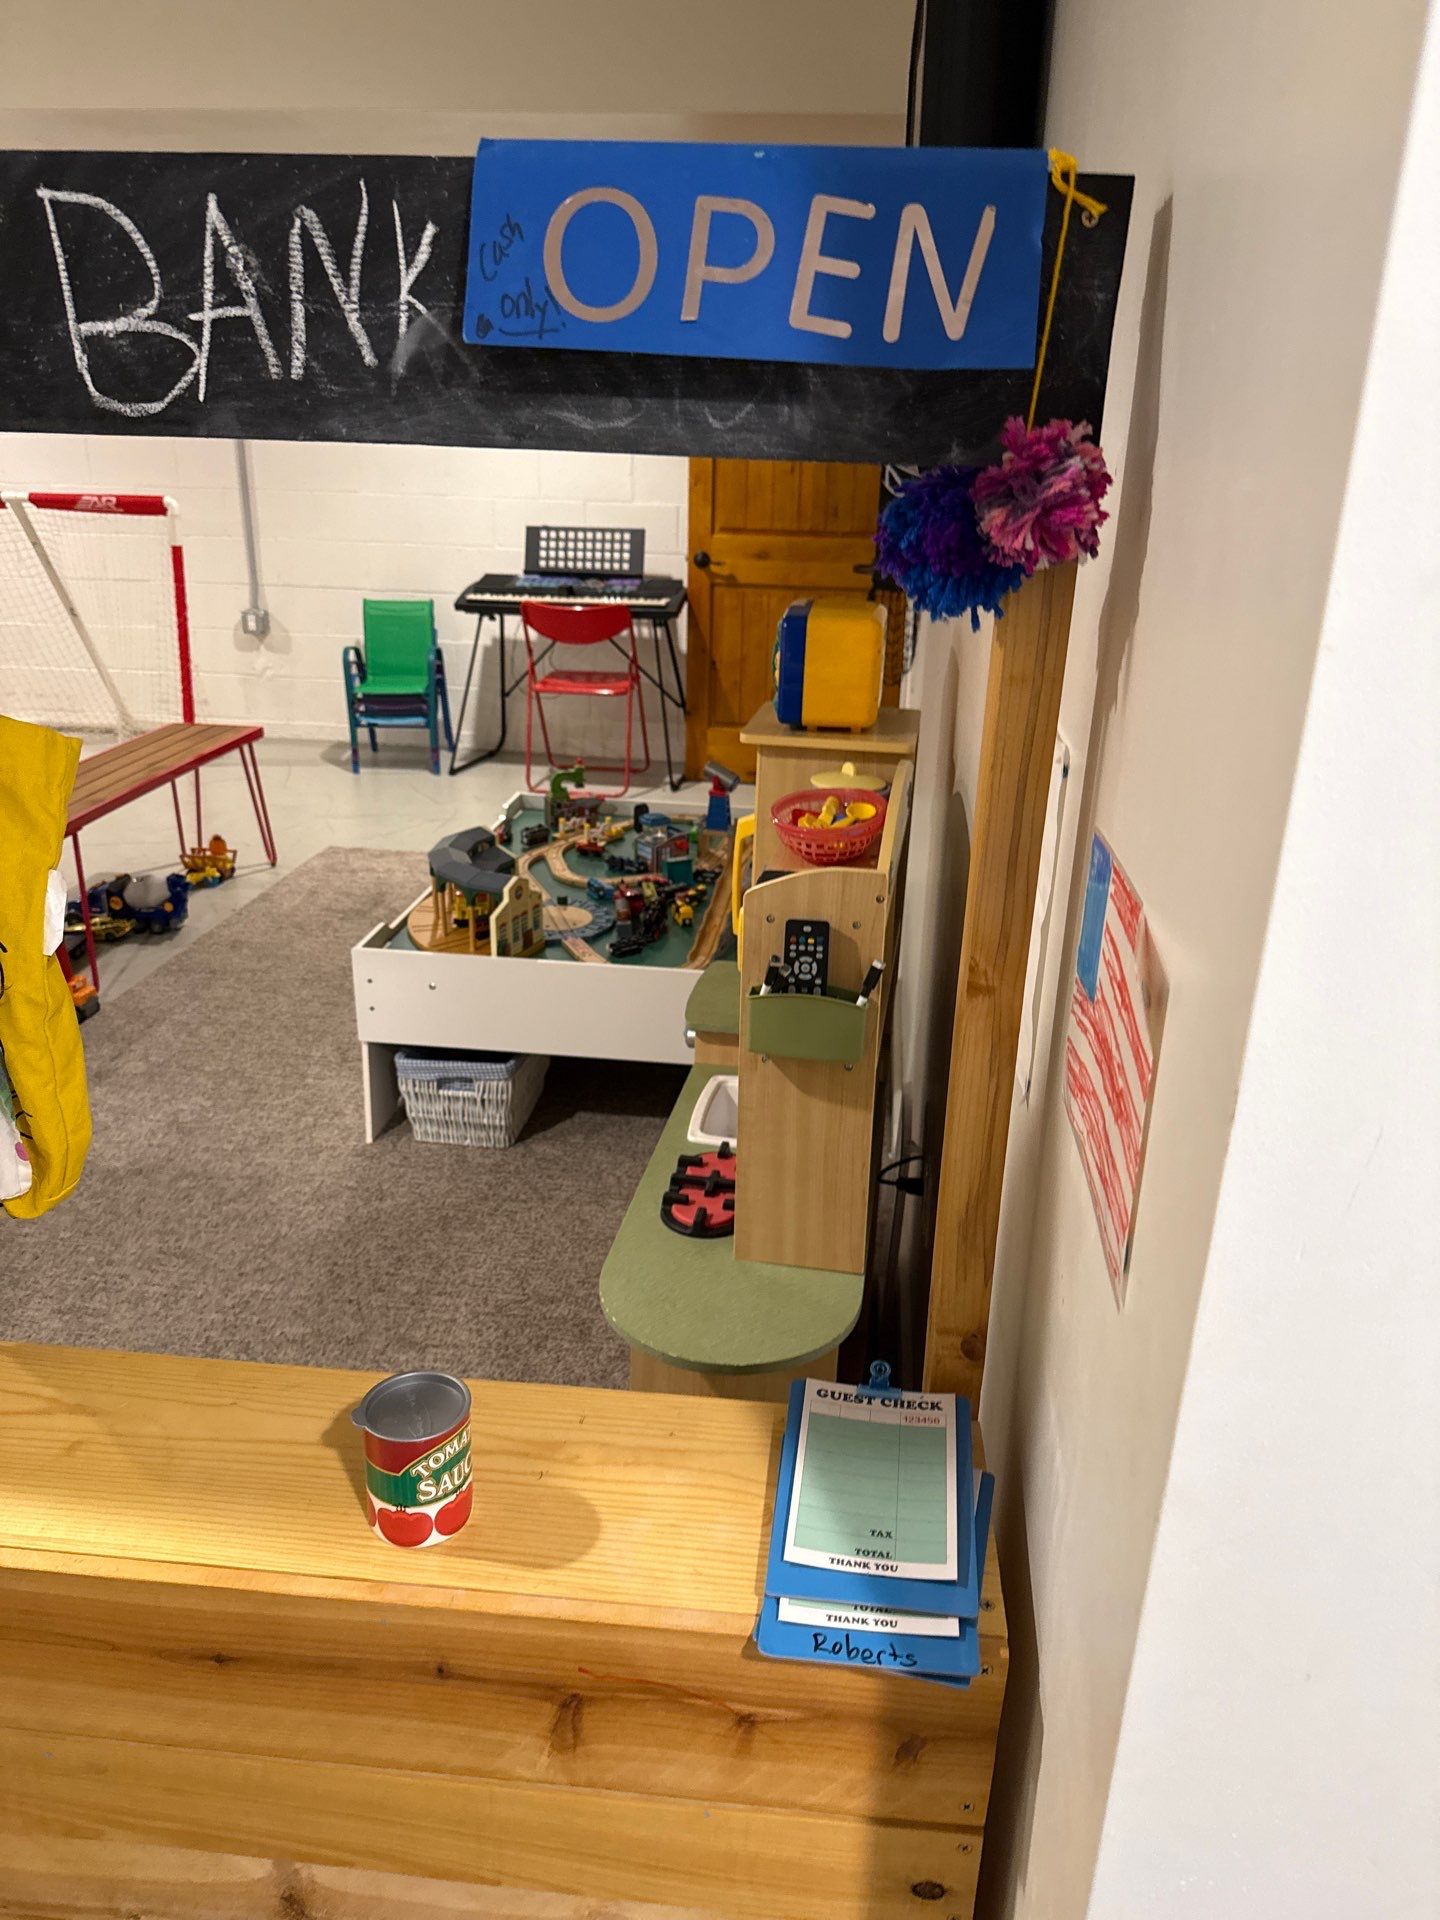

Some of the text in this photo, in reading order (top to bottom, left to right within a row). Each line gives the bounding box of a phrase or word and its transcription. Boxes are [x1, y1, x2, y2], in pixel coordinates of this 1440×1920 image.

[543, 187, 997, 344] OPEN
[36, 178, 440, 417] BANK
[816, 1388, 943, 1412] GUEST CHECK
[869, 1528, 893, 1539] TAX
[854, 1547, 893, 1560] TOTAL
[828, 1556, 899, 1573] THANK YOU
[825, 1613, 899, 1628] THANK YOU
[812, 1632, 918, 1667] Roberts
